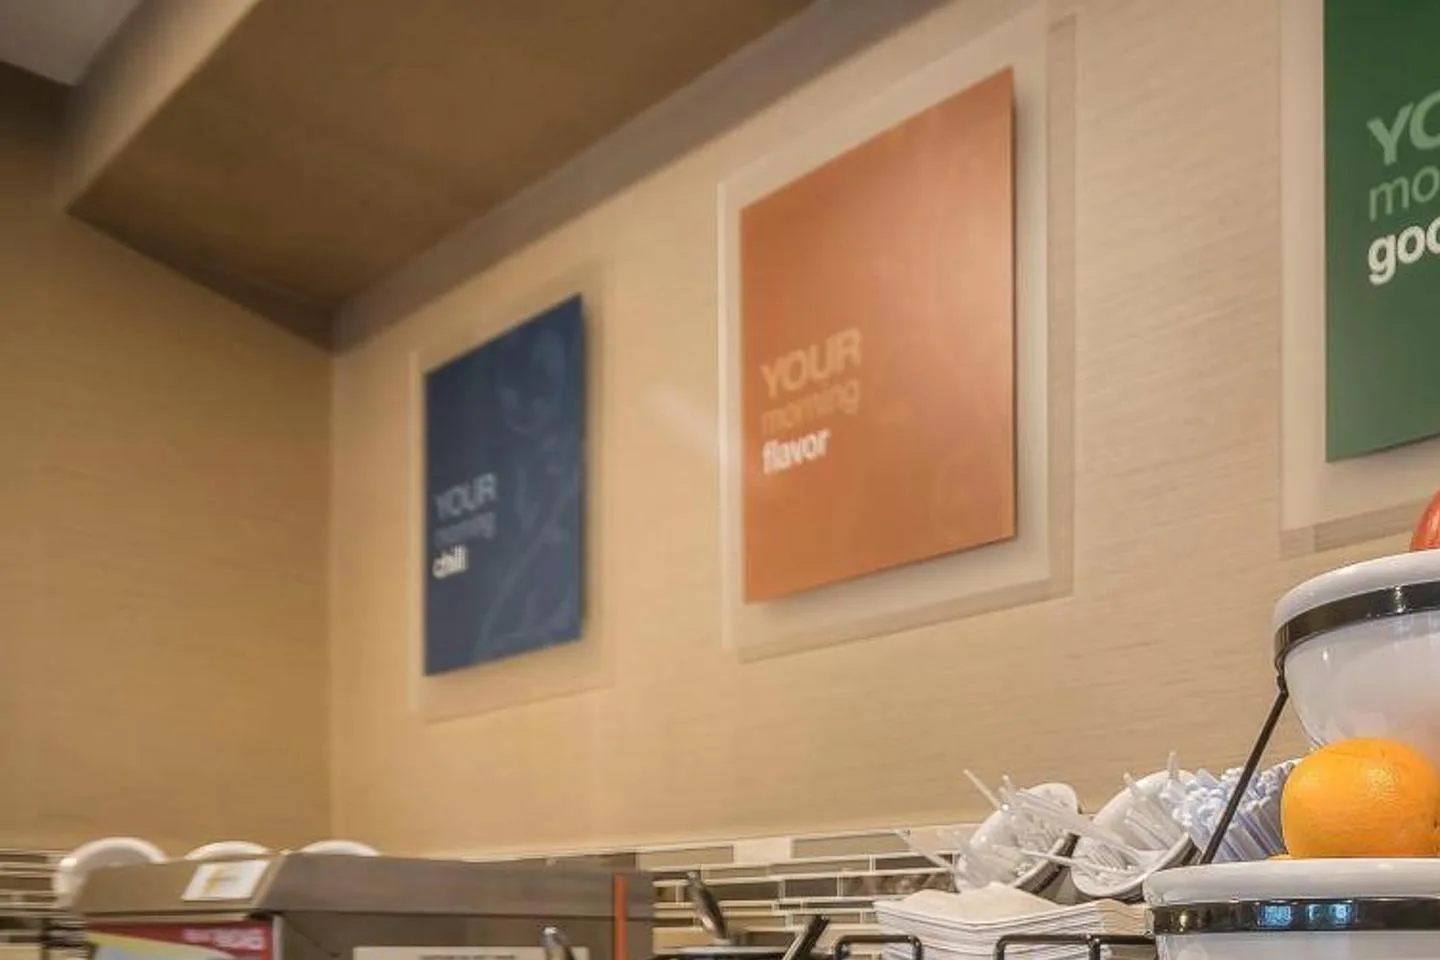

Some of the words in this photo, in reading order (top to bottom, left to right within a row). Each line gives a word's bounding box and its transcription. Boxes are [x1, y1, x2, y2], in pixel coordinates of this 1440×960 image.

[760, 328, 862, 400] YOUR
[763, 428, 831, 475] flavor
[436, 472, 497, 520] YOUR
